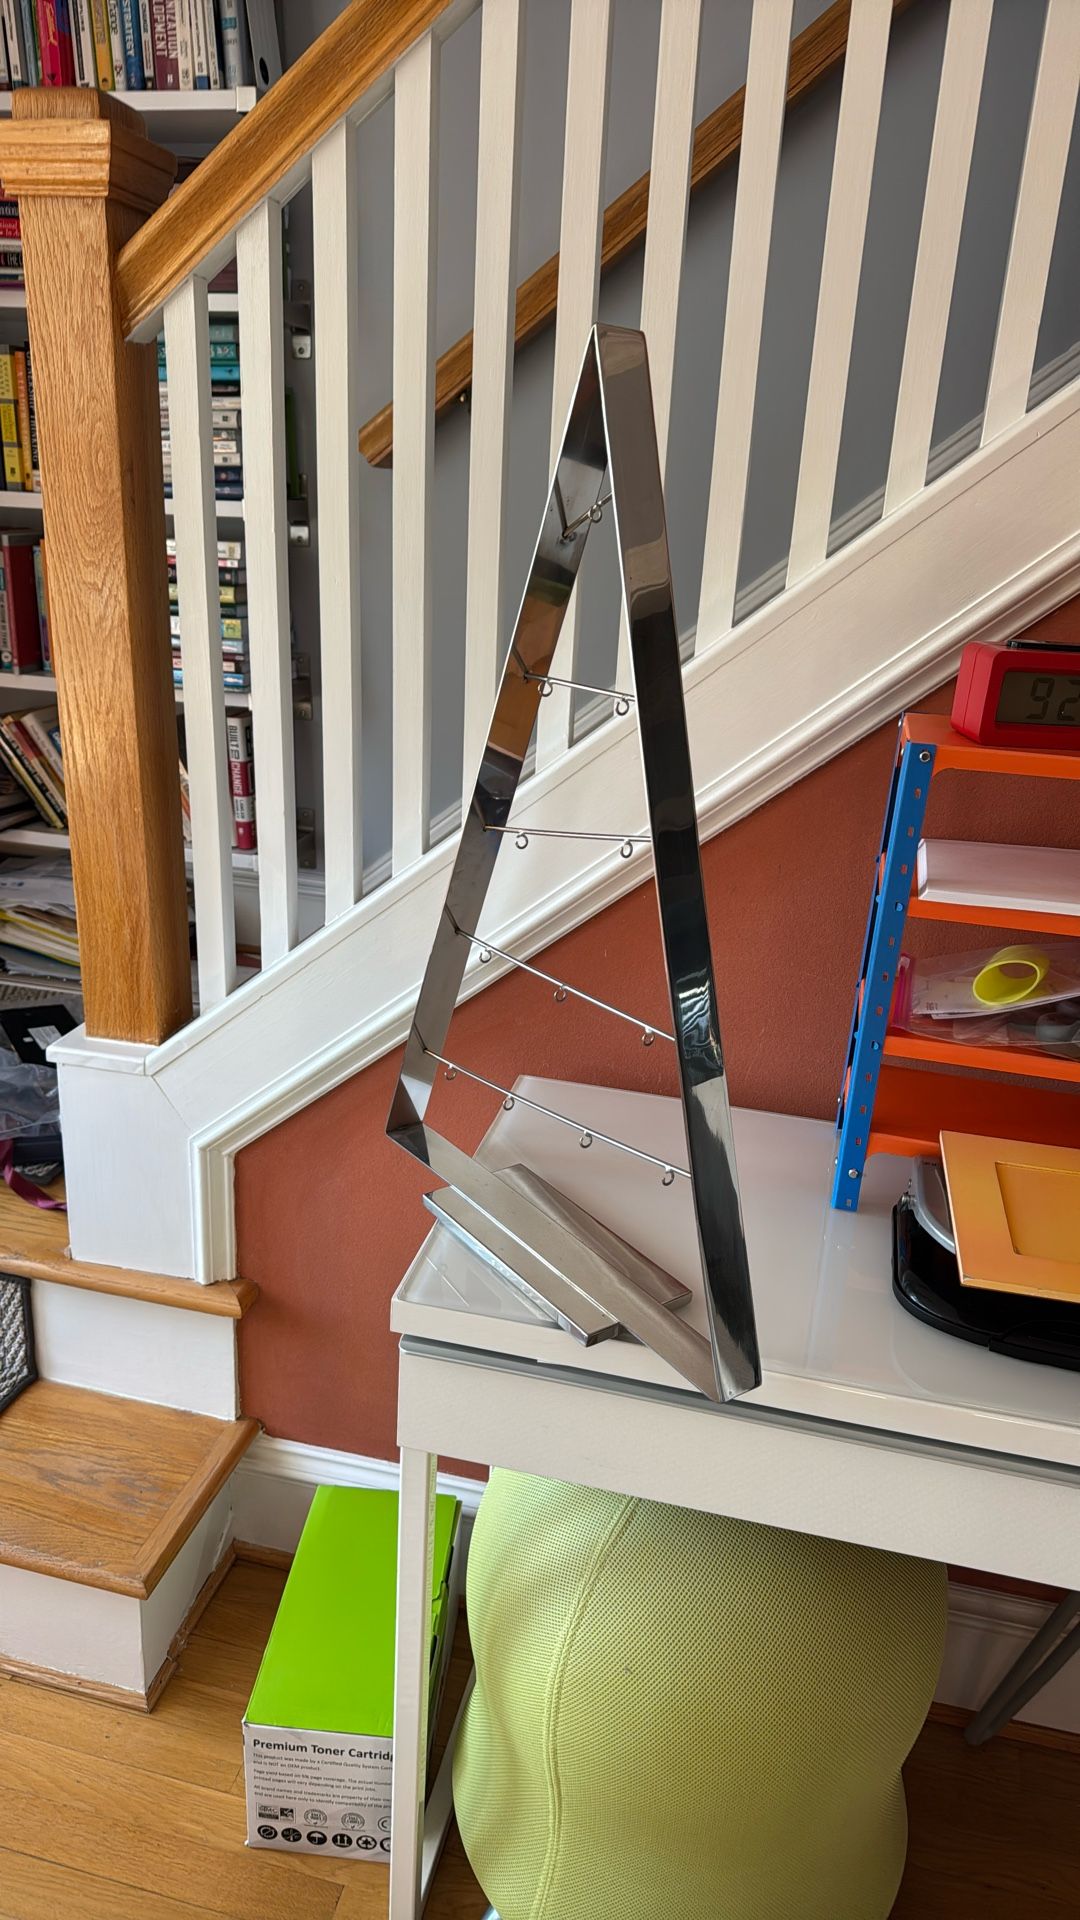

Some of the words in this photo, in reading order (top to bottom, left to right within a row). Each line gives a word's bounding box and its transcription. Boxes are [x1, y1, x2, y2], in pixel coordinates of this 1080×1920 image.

[231, 762, 243, 795] CHANGE
[253, 1739, 308, 1752] Premium
[311, 1744, 345, 1756] Toner
